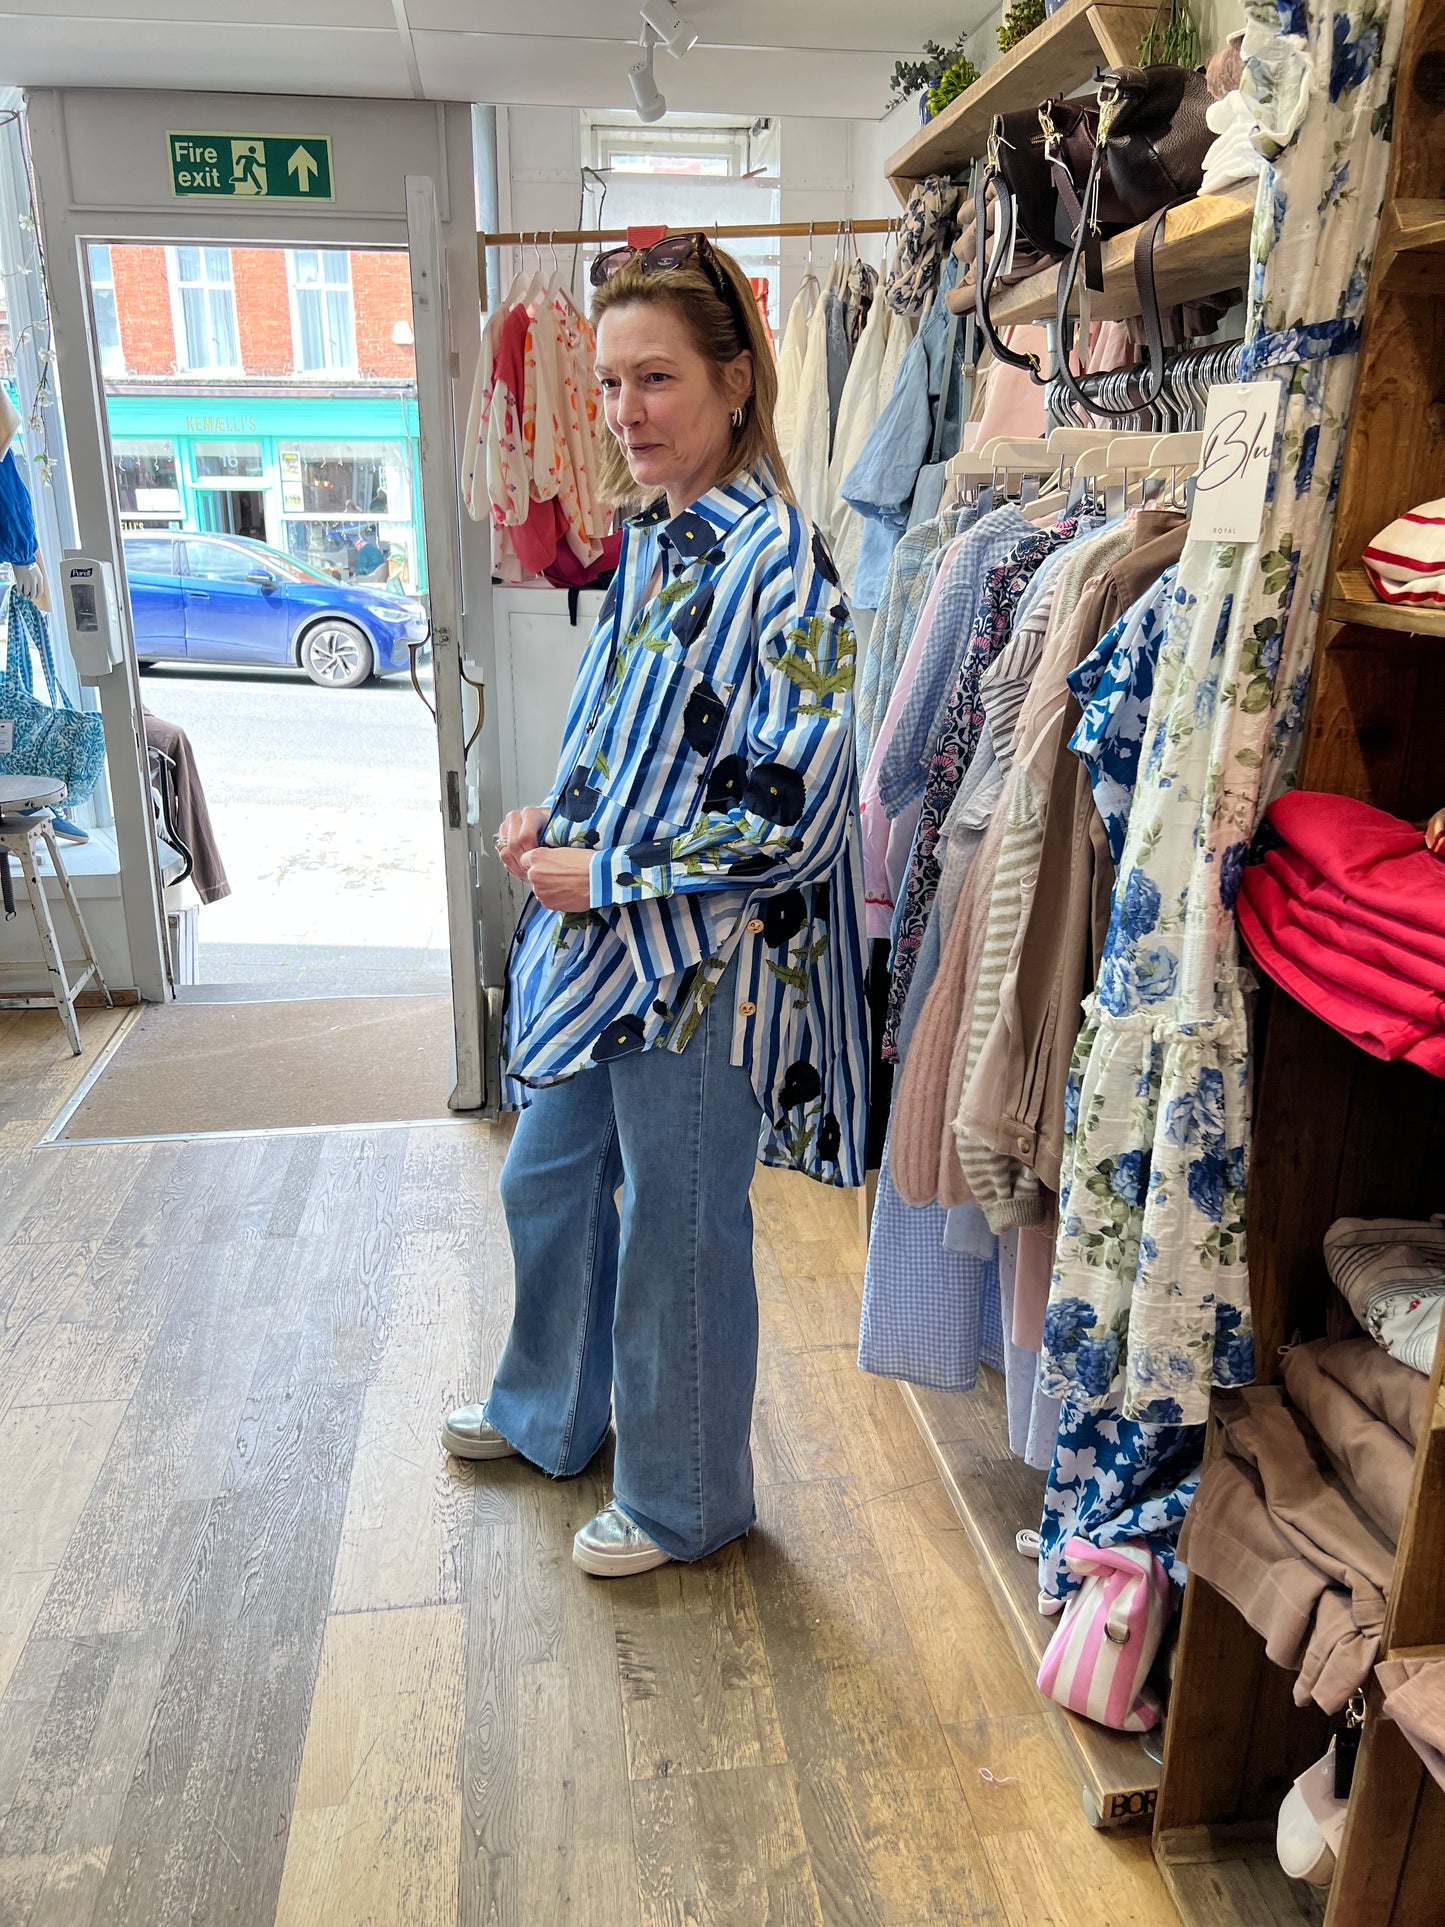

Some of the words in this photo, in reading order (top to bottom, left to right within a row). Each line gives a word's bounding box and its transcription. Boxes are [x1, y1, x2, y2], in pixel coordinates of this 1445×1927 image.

[174, 142, 218, 163] Fire
[178, 167, 221, 187] exit
[222, 455, 239, 468] 16
[1213, 527, 1236, 535] ROYAL
